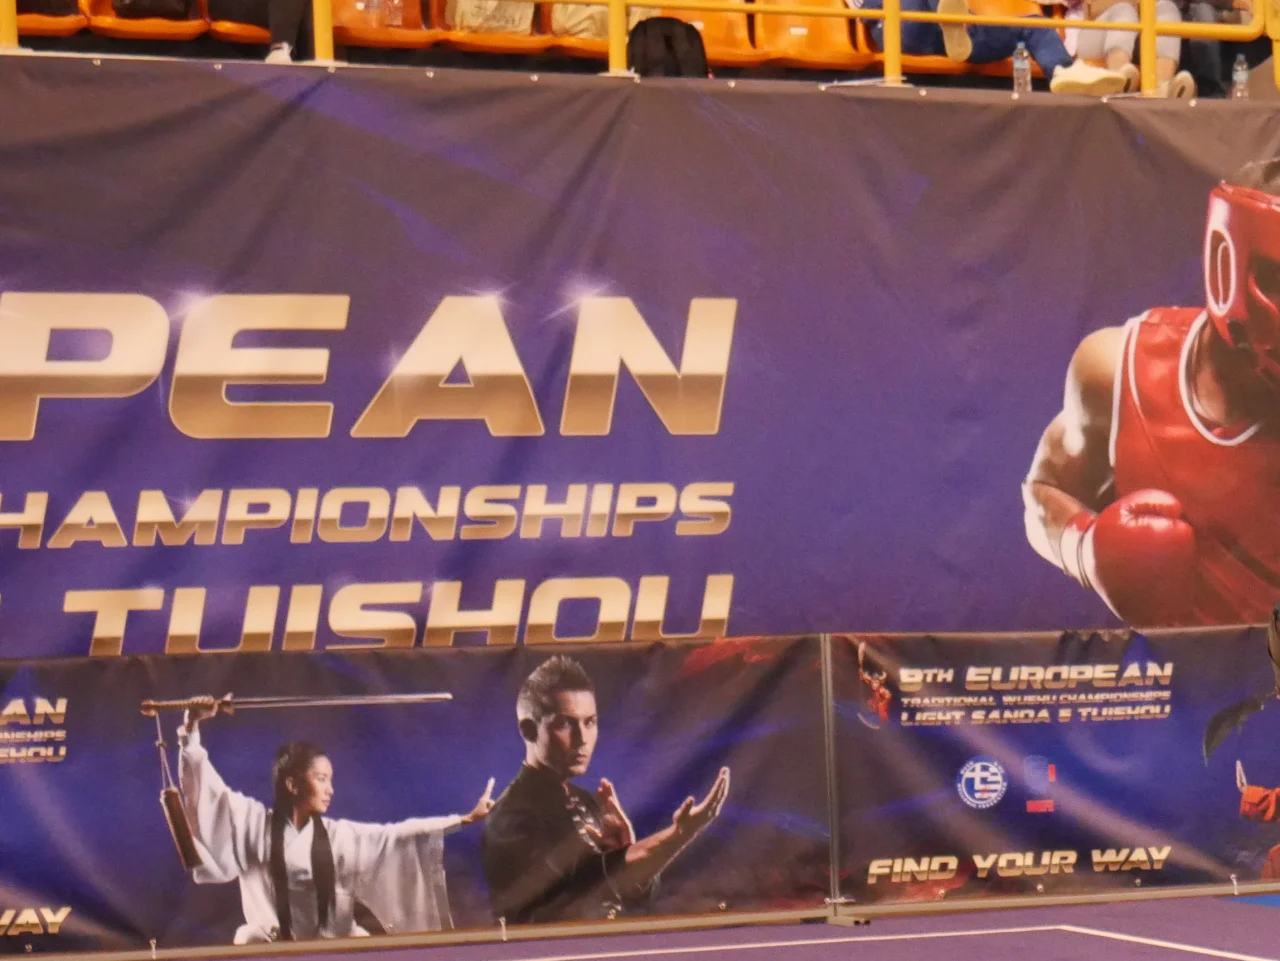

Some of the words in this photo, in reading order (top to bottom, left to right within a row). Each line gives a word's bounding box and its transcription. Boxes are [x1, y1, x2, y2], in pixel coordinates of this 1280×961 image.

[63, 574, 735, 657] TUISHOU
[965, 662, 1173, 690] EUROPEAN
[901, 710, 965, 726] LIGHT
[971, 708, 1050, 724] SANDA
[1078, 704, 1171, 722] TUISHOU
[867, 856, 958, 884] FIND
[972, 849, 1078, 878] YOUR
[1091, 845, 1172, 872] WAY
